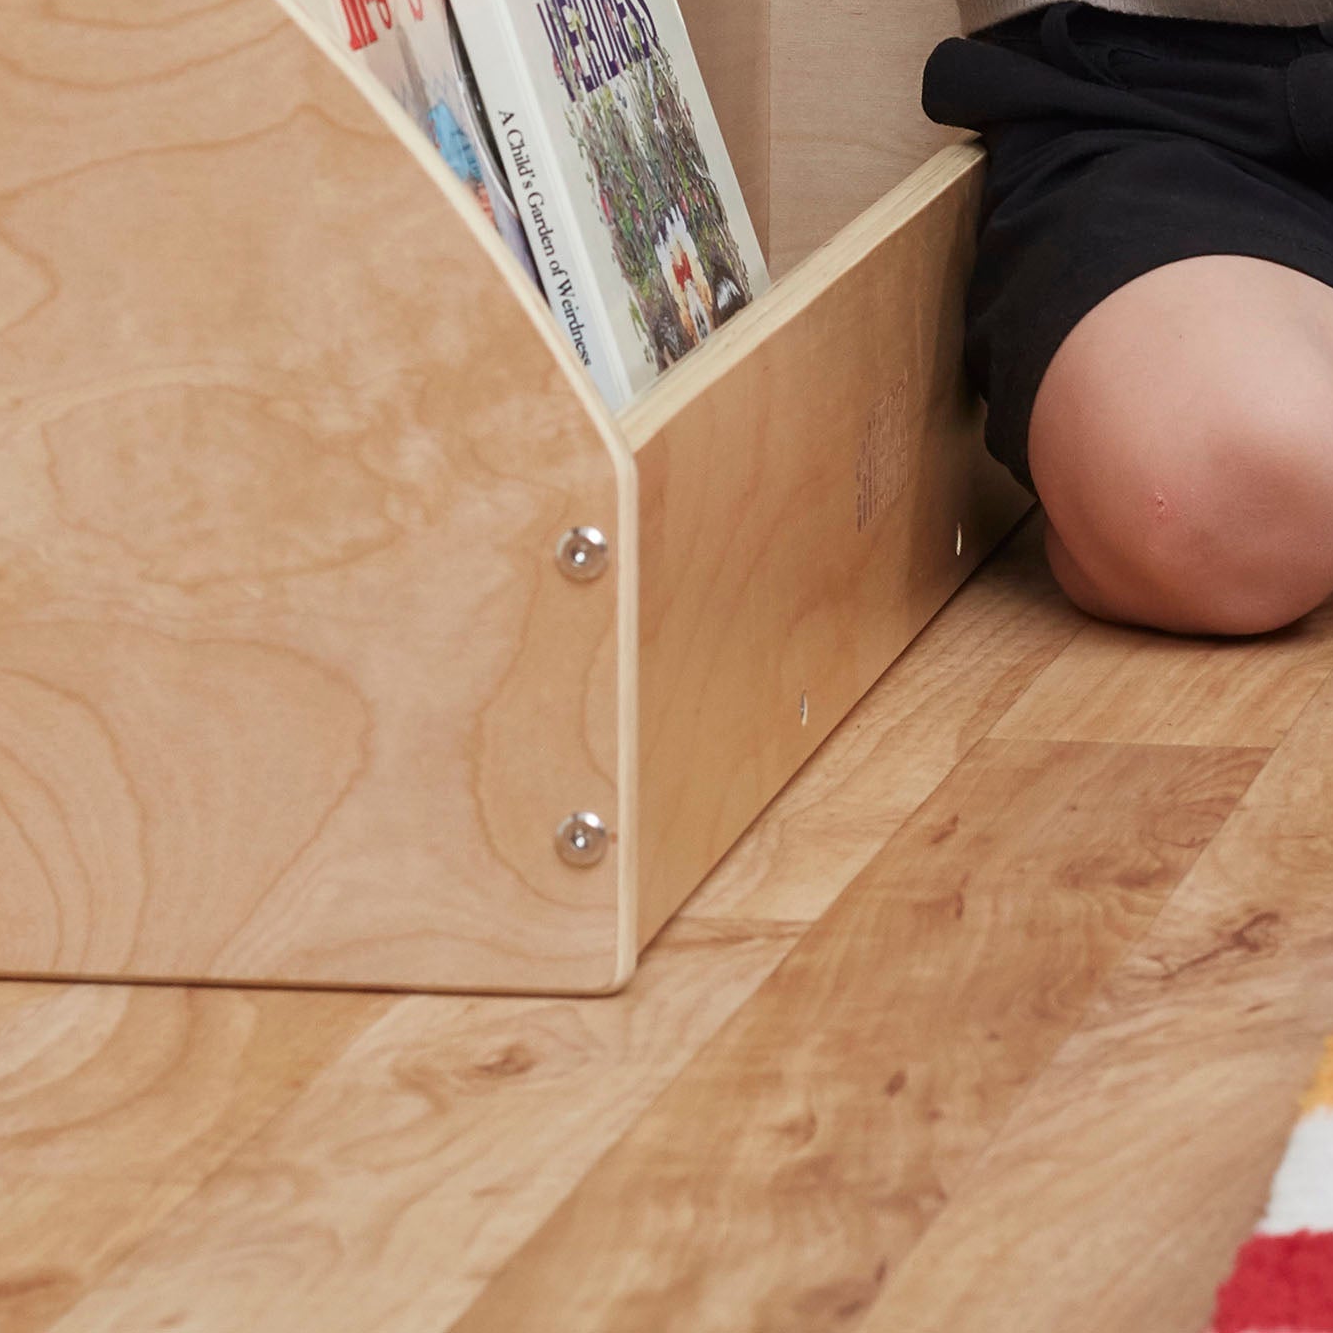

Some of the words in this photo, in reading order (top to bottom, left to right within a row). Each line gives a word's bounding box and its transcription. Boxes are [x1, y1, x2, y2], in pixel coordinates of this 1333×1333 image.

[498, 109, 515, 126] A
[506, 129, 536, 190] Child's
[527, 191, 555, 257] Garden
[549, 259, 568, 279] of
[557, 278, 592, 368] Weirdness
